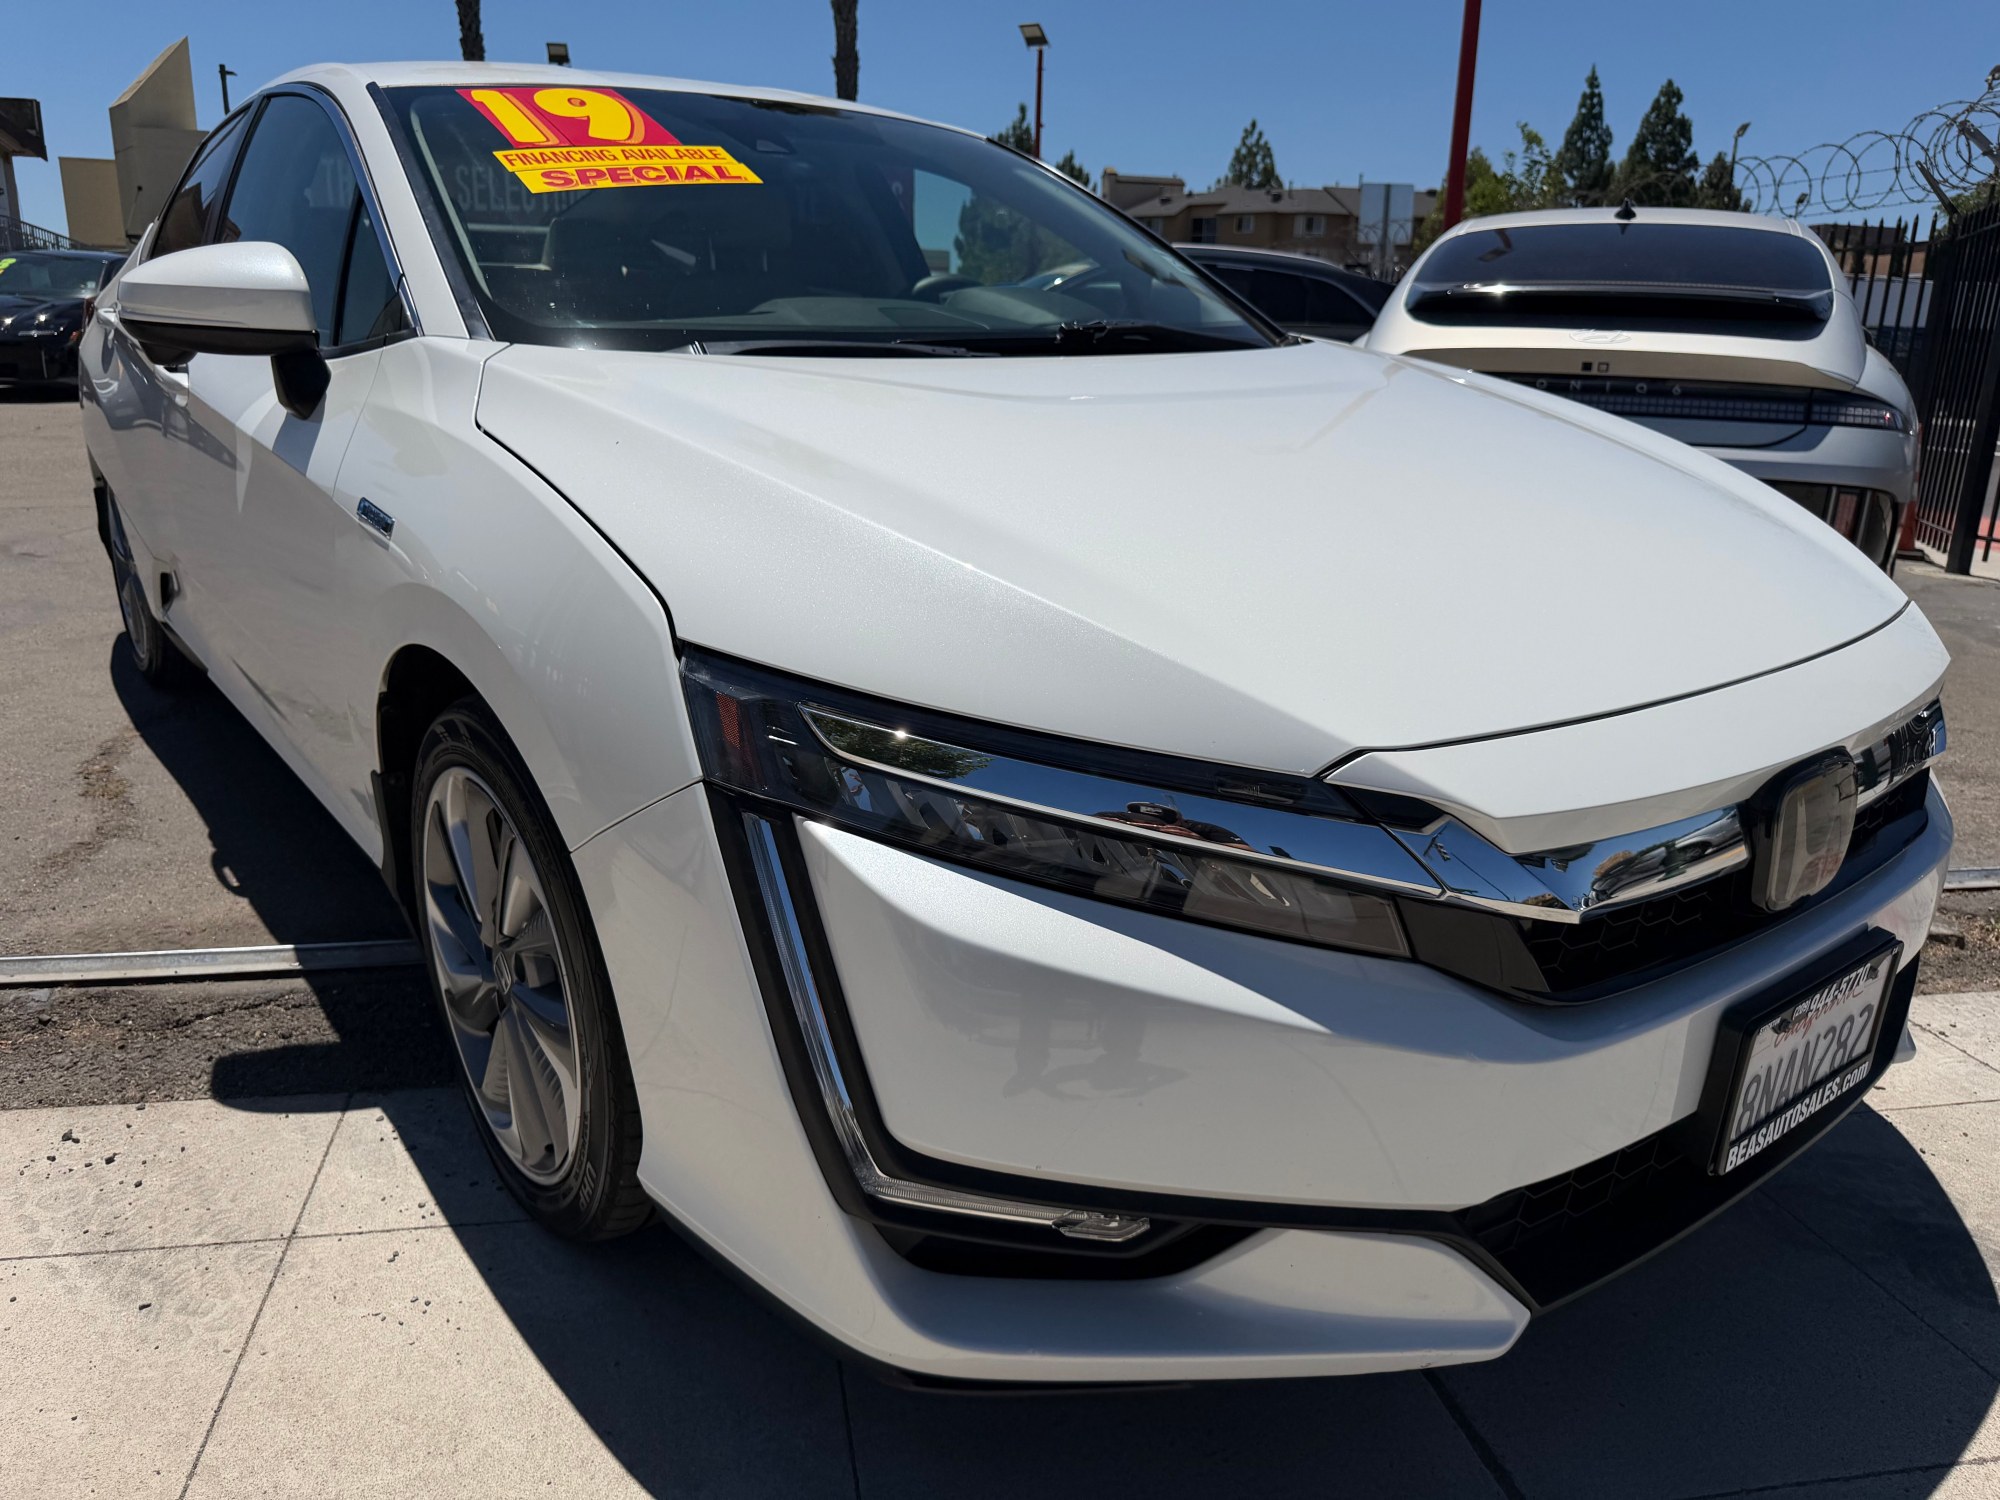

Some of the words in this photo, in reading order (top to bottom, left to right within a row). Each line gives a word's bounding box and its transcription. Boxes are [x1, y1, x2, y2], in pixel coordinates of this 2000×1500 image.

[471, 88, 645, 144] 19
[503, 149, 617, 167] FINANCING
[623, 148, 727, 162] AVAILABLE
[540, 165, 747, 188] SPECIAL
[1810, 963, 1871, 1014] 944-5770
[1735, 1003, 1875, 1138] 8NAN282
[1725, 1061, 1870, 1172] BEASAUTOSALES.com
[579, 1161, 597, 1210] UHP
